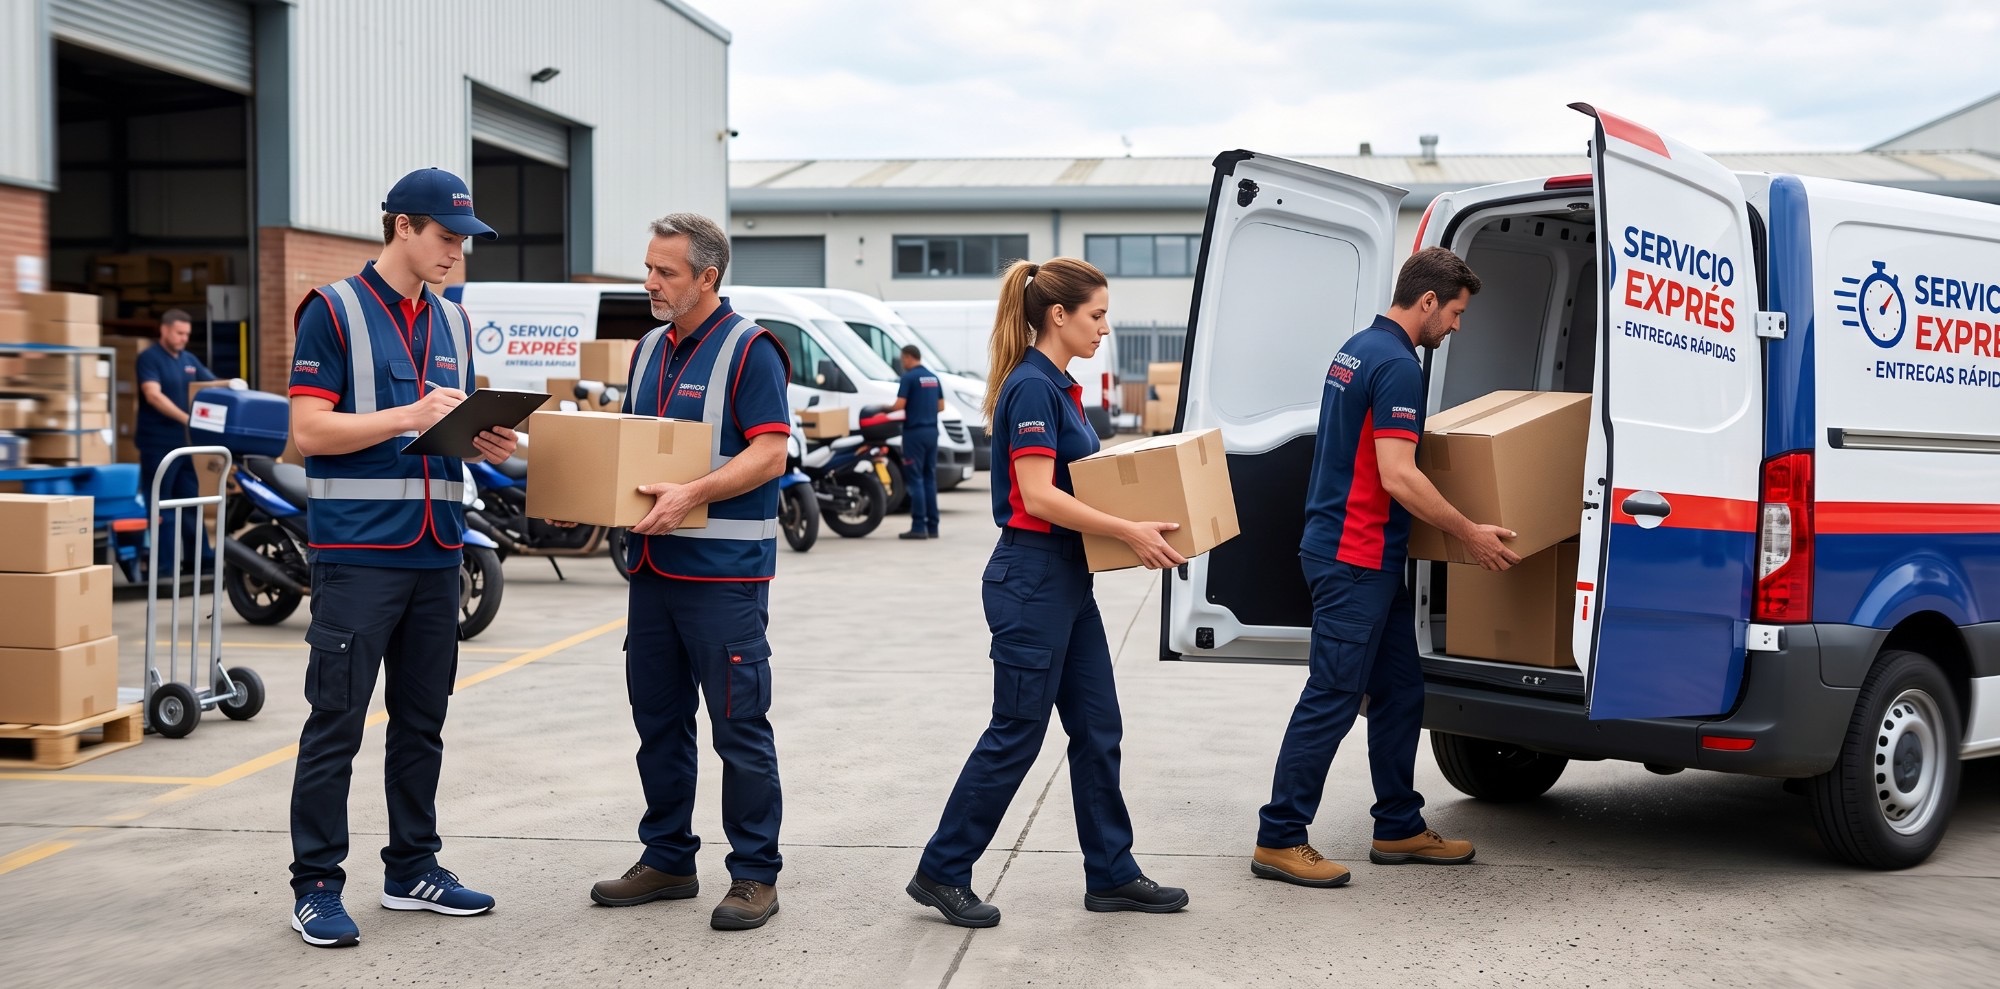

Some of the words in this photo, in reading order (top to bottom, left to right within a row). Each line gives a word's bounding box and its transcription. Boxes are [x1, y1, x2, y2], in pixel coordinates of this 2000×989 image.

[1623, 225, 1734, 287] SERVICIO
[1624, 268, 1735, 333] EXPRÉS
[507, 338, 577, 356] EXPRÉS
[509, 324, 579, 337] SERVICIO
[1624, 320, 1687, 350] ENTREGAS
[1690, 336, 1736, 362] RÁPIDAS
[1875, 360, 1954, 384] ENTREGAS
[1958, 365, 2000, 388] RÁPID
